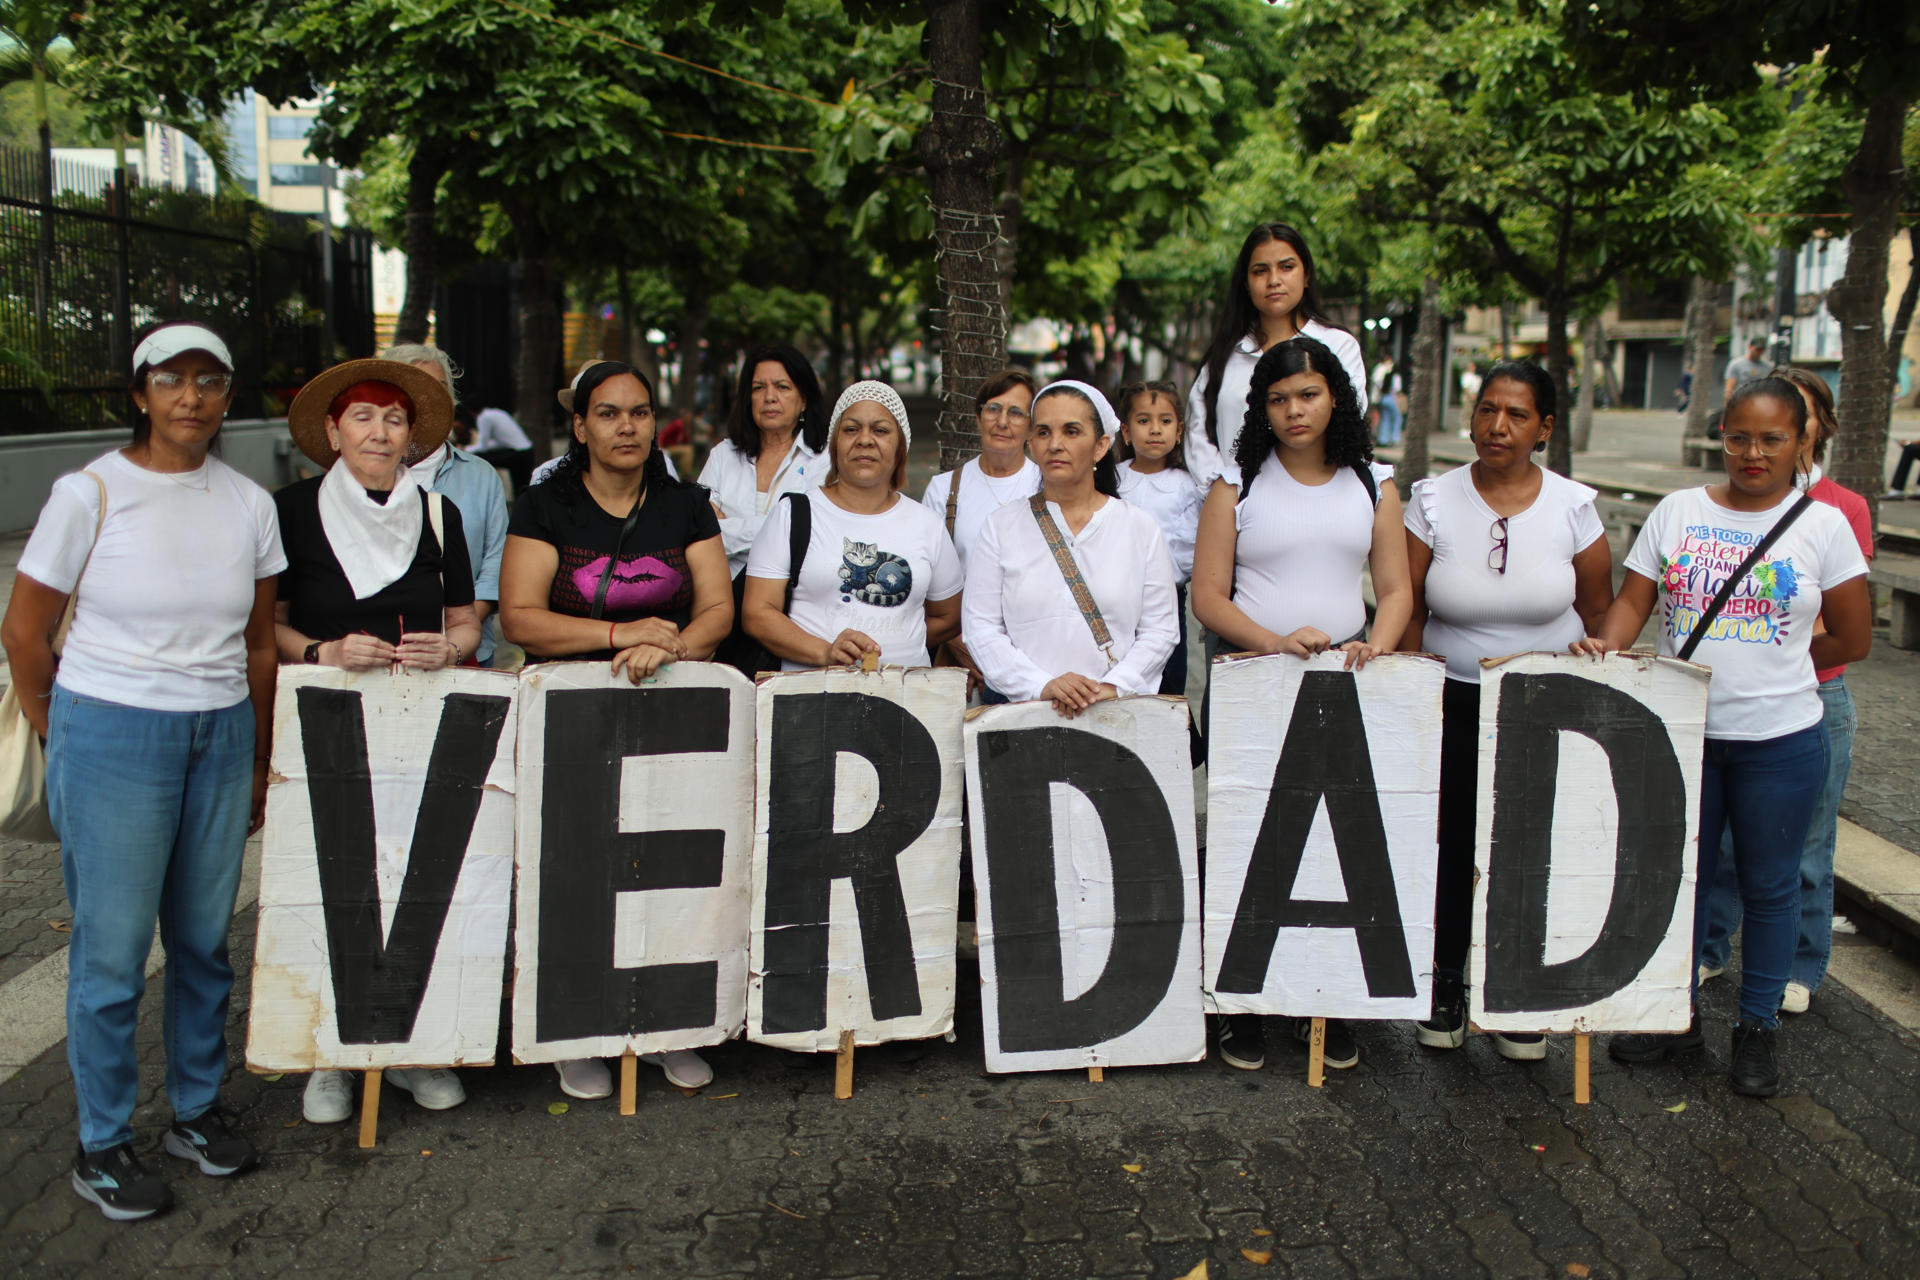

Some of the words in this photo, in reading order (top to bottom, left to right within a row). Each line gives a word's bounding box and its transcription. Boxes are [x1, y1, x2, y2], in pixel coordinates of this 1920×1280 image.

[1686, 526, 1709, 539] ME
[1674, 592, 1693, 609] TE
[296, 670, 1687, 1054] VERDAD
